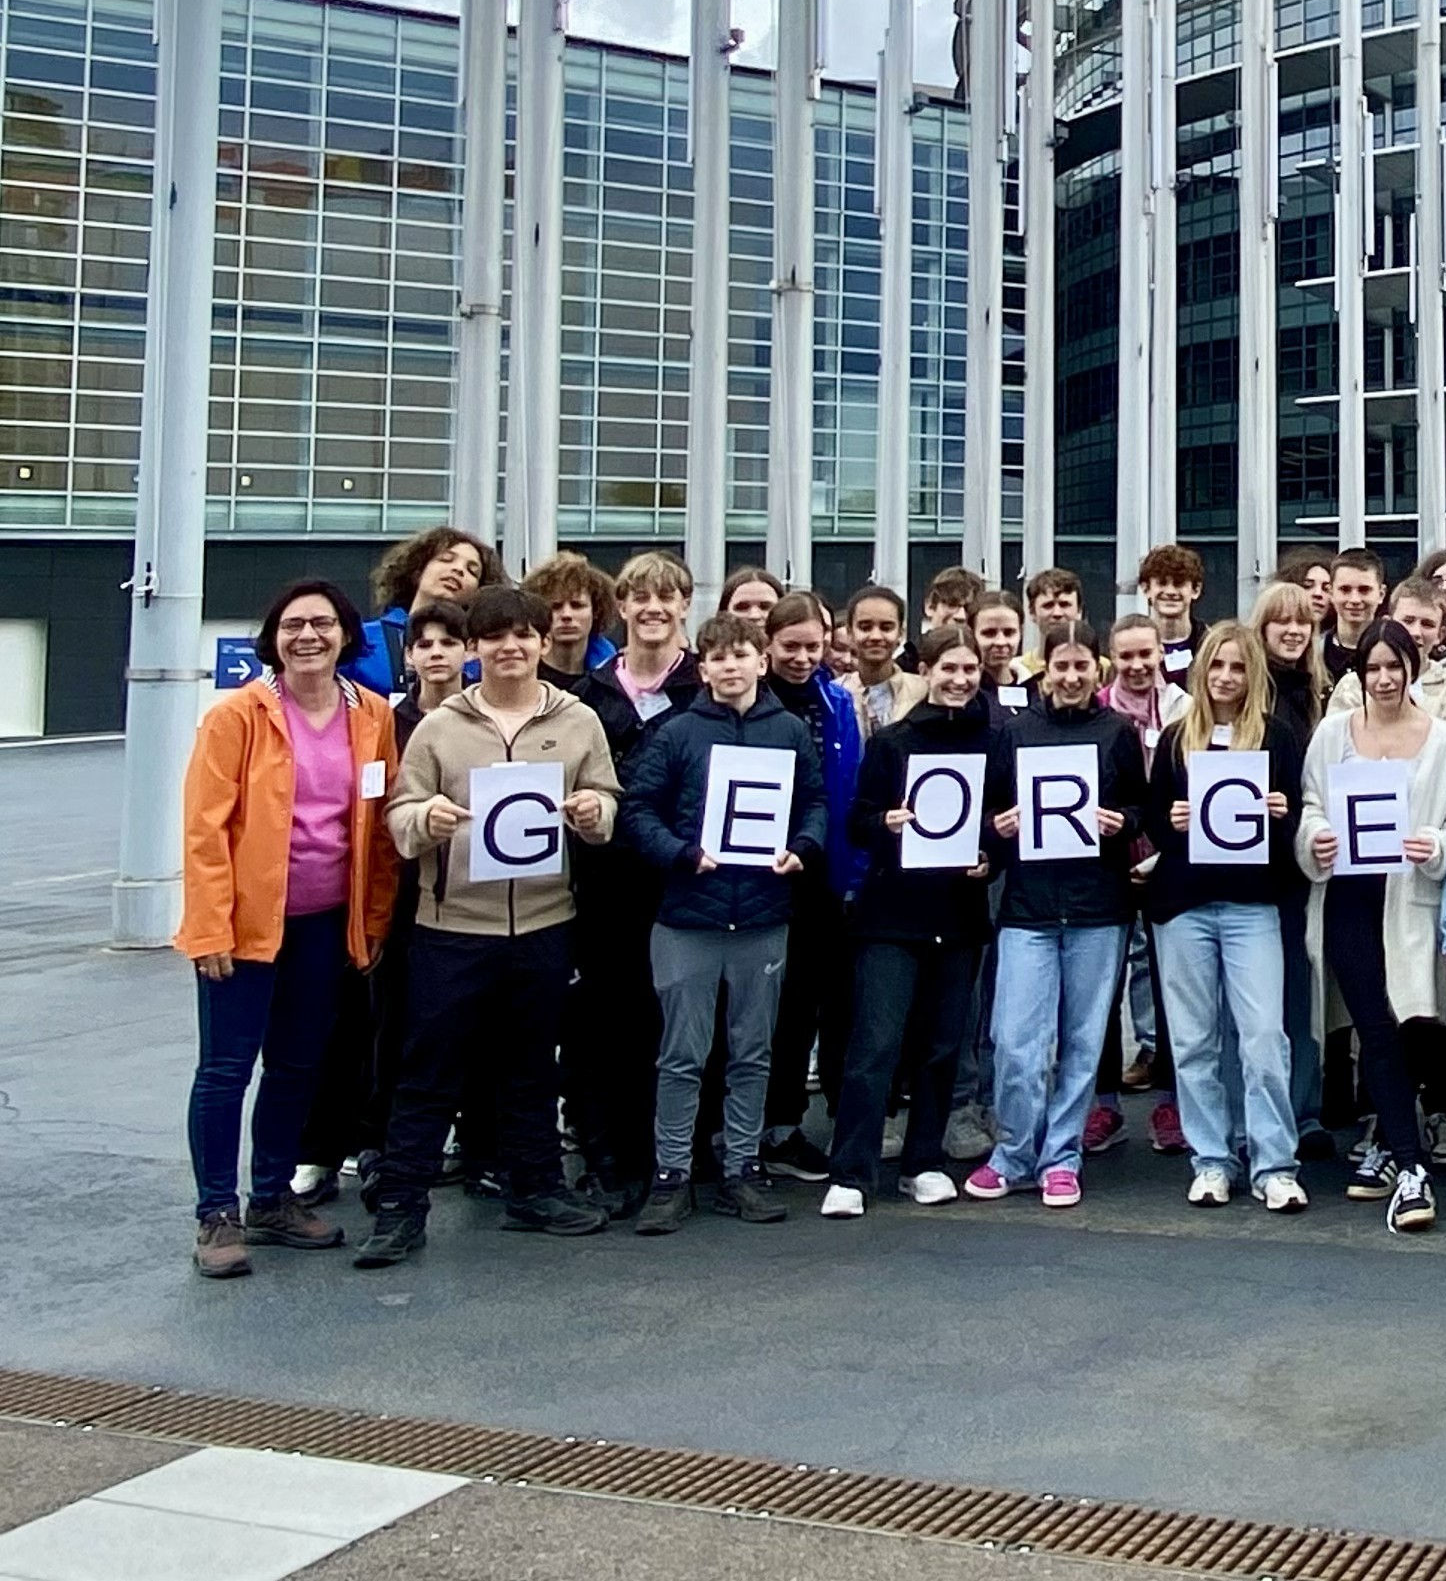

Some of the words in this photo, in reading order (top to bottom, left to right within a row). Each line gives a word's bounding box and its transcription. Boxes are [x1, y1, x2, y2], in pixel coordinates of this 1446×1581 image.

[484, 792, 559, 865] G
[720, 780, 782, 855] E
[906, 767, 972, 839] O
[1033, 775, 1097, 849] R
[1200, 778, 1265, 850] G
[1347, 793, 1403, 865] E
